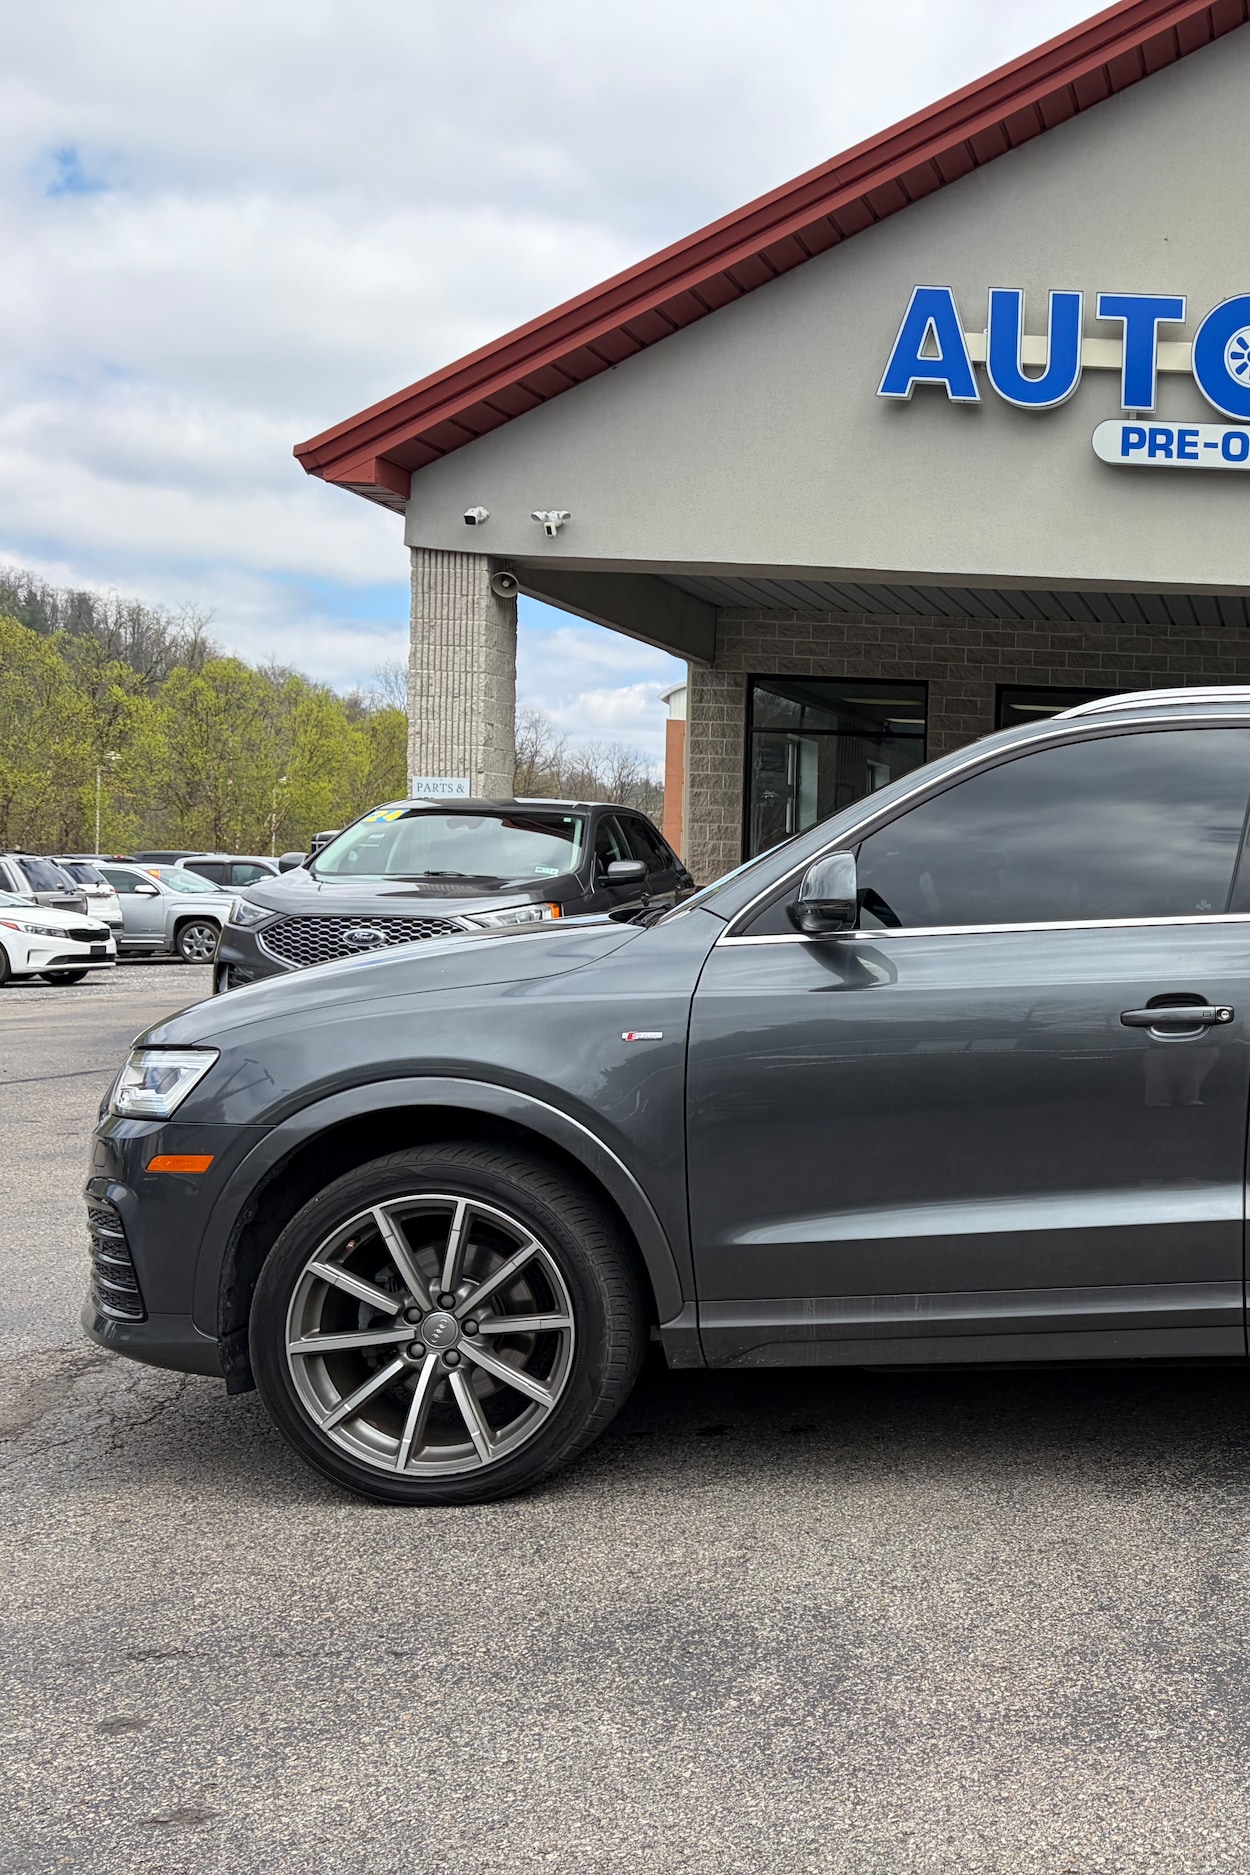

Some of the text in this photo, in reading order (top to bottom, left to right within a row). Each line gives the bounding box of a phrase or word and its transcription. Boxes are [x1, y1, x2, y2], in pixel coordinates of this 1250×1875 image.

[416, 782, 465, 794] PARTS &
[352, 932, 375, 942] Ford
